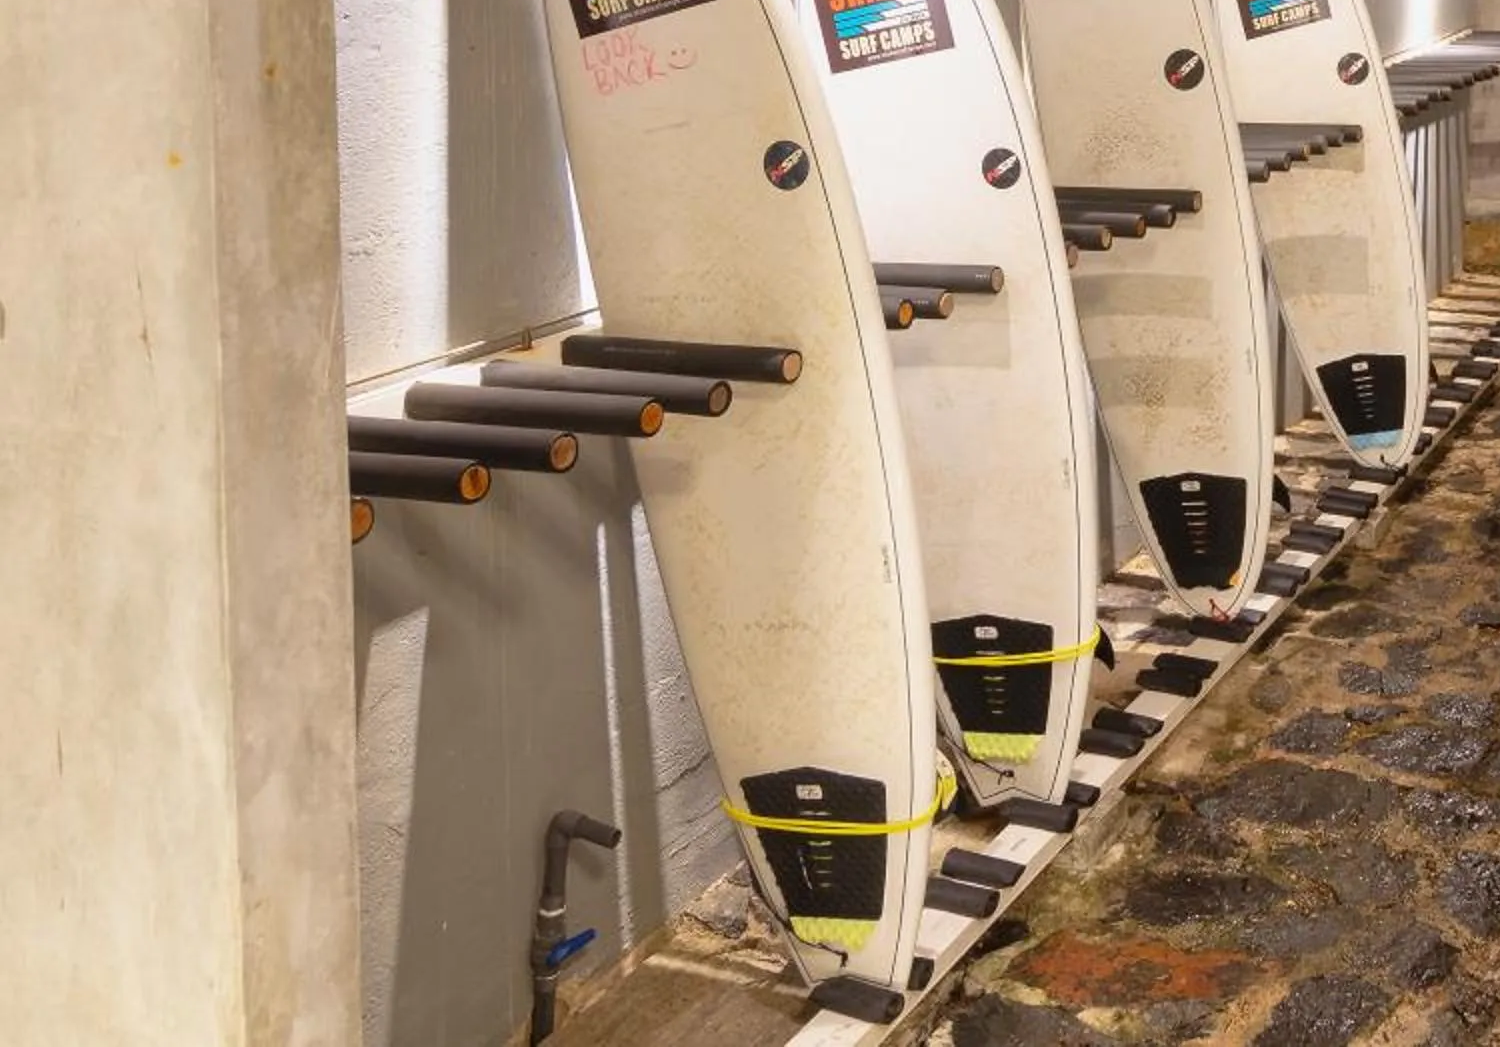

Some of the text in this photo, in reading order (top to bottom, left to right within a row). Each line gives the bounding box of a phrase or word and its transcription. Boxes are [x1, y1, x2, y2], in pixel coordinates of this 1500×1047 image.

[1252, 13, 1281, 30] SURF
[1281, 1, 1320, 22] CAMPS
[839, 34, 877, 60] SURF
[879, 21, 935, 52] CAMPS
[594, 52, 668, 96] BACK
